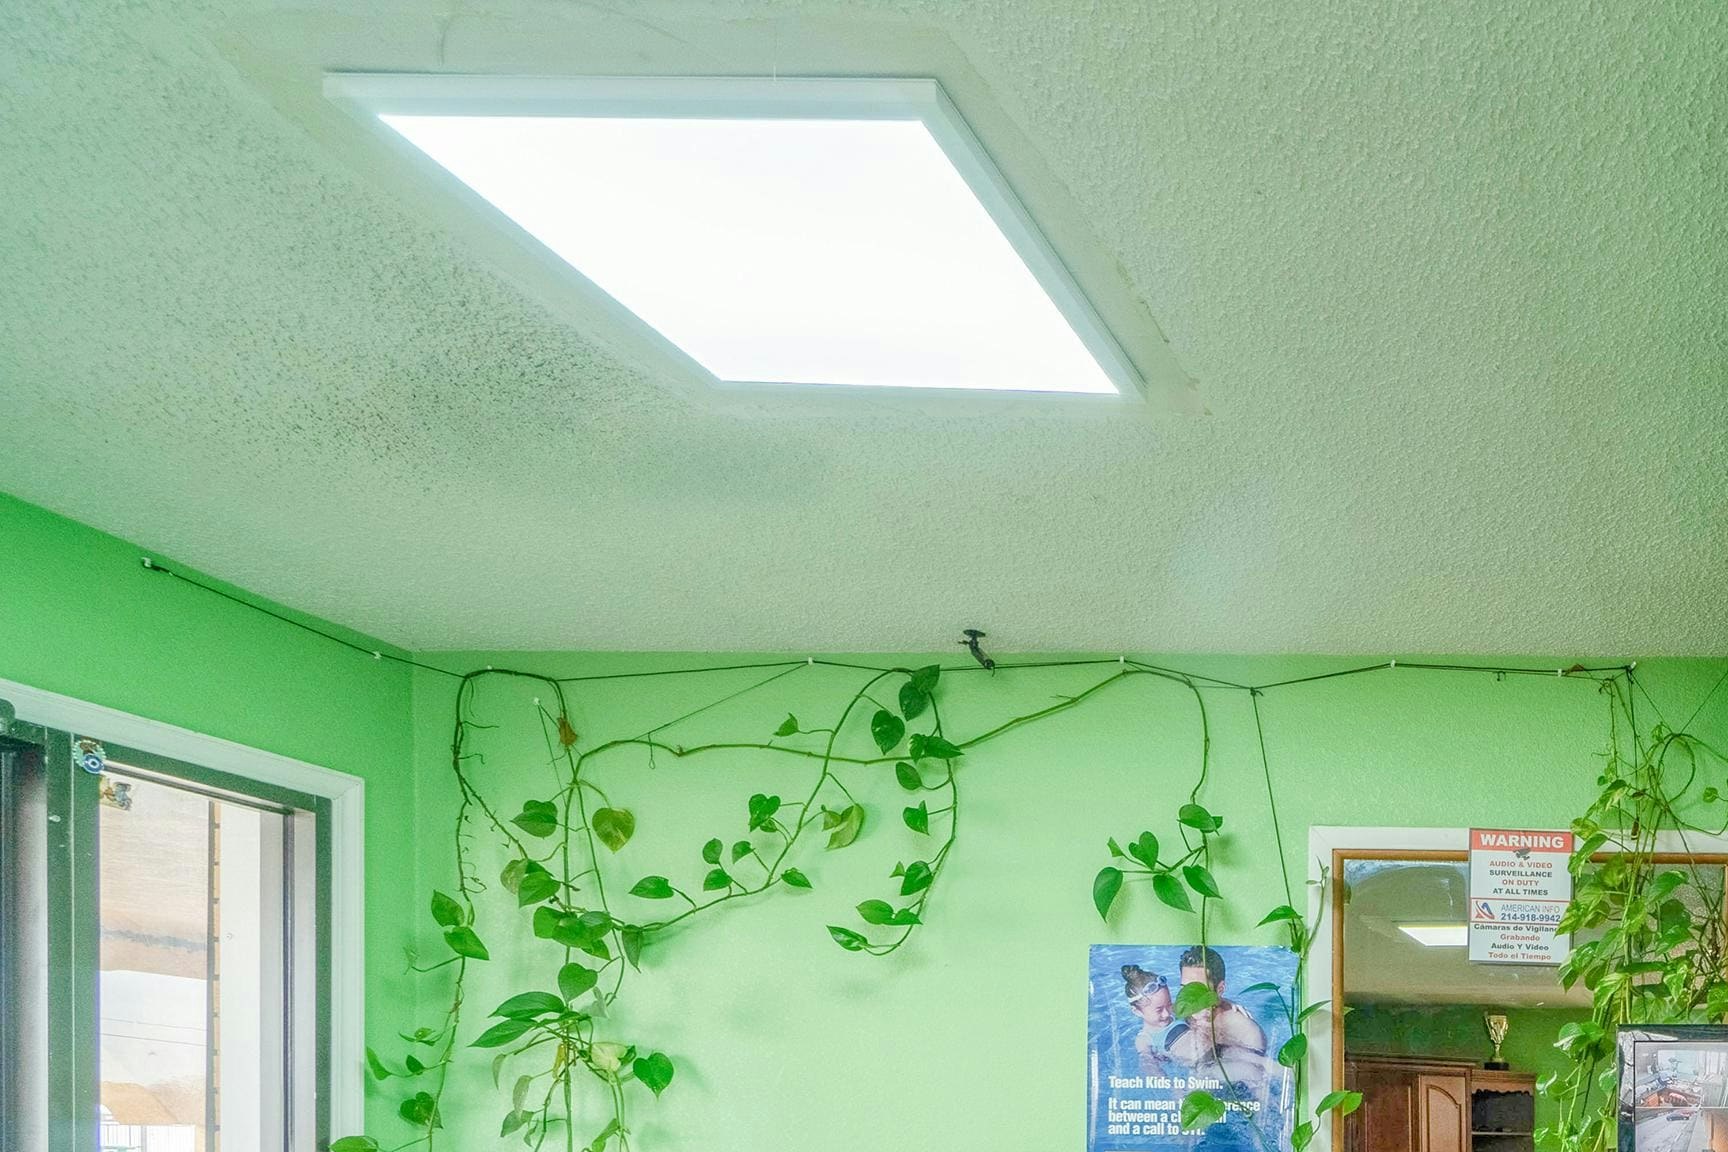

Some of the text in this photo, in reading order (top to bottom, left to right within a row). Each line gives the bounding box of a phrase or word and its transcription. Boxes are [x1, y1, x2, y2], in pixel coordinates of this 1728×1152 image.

[1480, 834, 1564, 848] WARNING
[1526, 861, 1553, 869] VIDEO
[1489, 869, 1553, 878] SURVEILLANCE
[1523, 888, 1549, 896] TIMES
[1501, 904, 1560, 913] AMERICAN INFO
[1501, 912, 1560, 922] 214-918-9942
[1526, 925, 1557, 933] Vigilan
[1500, 933, 1540, 941] Grabando
[1491, 942, 1514, 950] Audio
[1525, 943, 1549, 951] Video
[1488, 951, 1508, 959] Todo
[1521, 952, 1551, 960] Tiempo
[1108, 1076, 1223, 1089] Teach Kids to Swim.
[1108, 1098, 1117, 1110] It
[1120, 1100, 1142, 1110] can
[1144, 1100, 1176, 1110] mean
[1108, 1111, 1158, 1123] between
[1160, 1113, 1168, 1122] a
[1108, 1123, 1130, 1135] and
[1133, 1125, 1140, 1135] a
[1143, 1123, 1164, 1135] call
[1168, 1124, 1179, 1135] to
